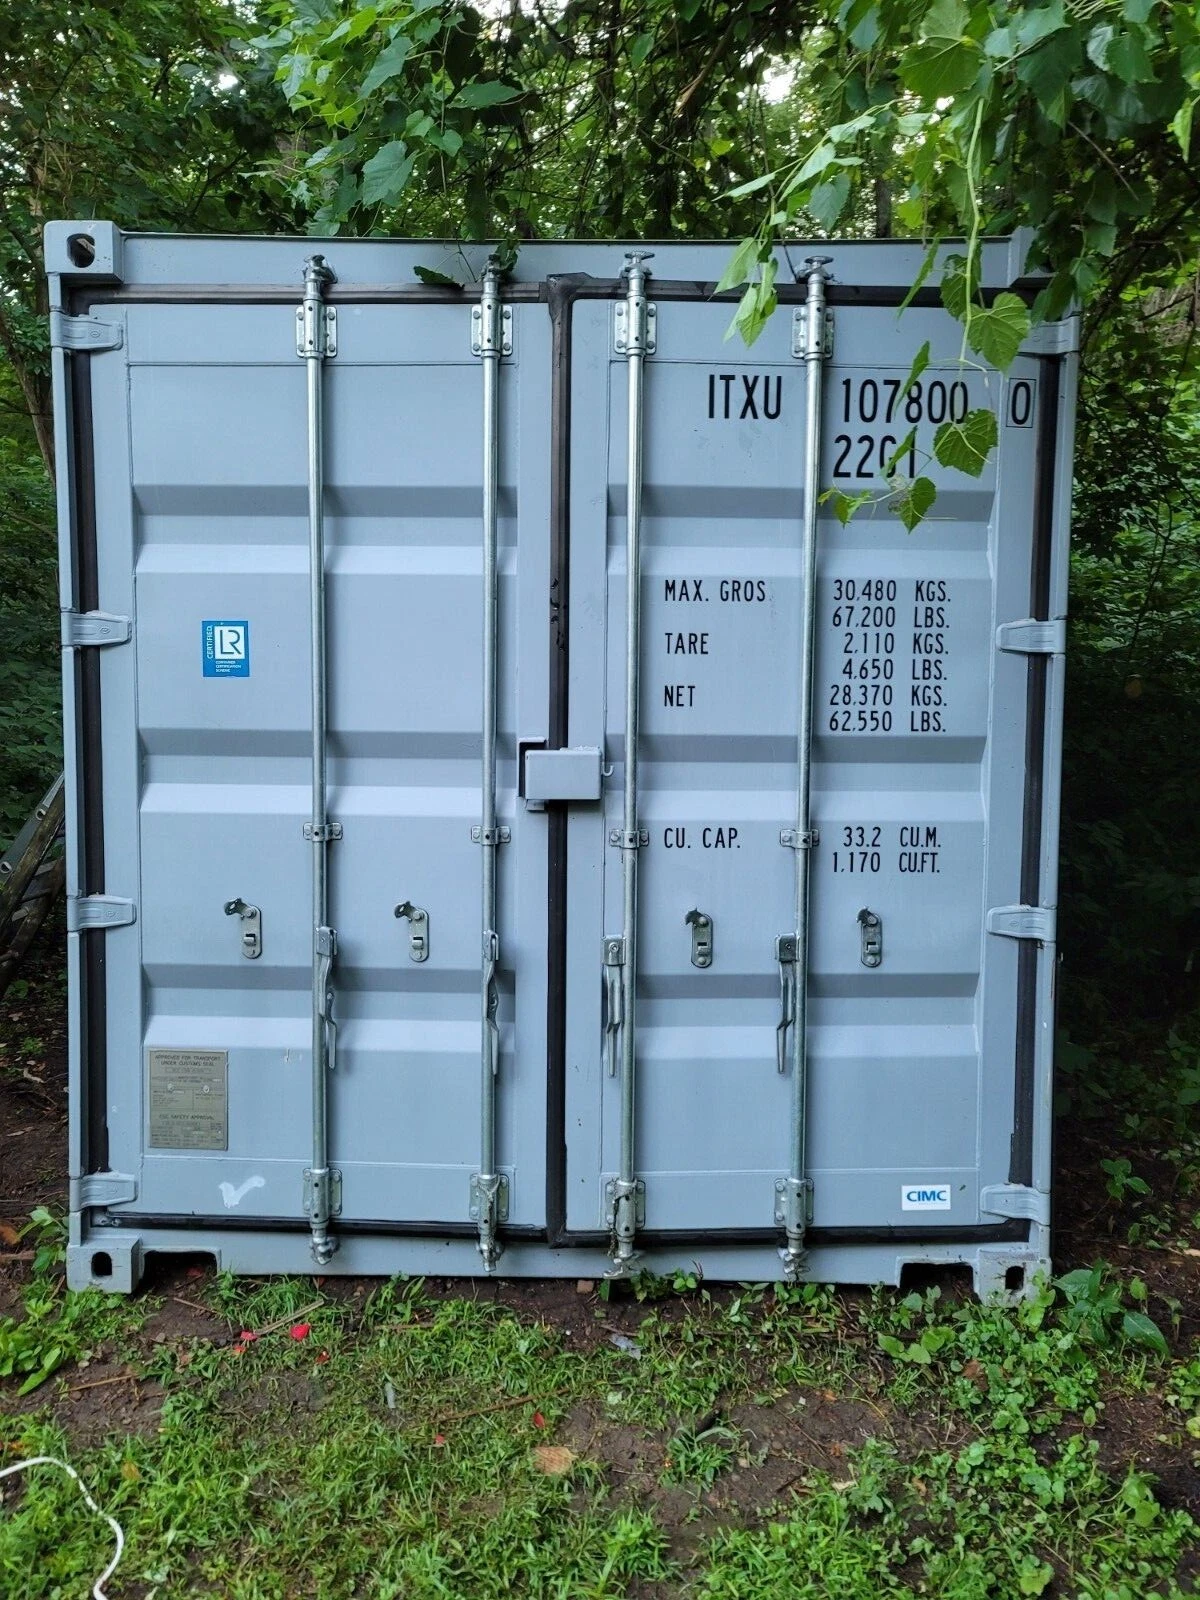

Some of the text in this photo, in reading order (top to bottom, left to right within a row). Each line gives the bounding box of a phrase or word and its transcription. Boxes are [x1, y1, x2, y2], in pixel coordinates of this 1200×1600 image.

[708, 374, 1032, 426] ITXU 107800 0
[664, 578, 952, 603] MAX. GROS 30,480 KGS.
[831, 605, 950, 629] 67,200 LBS.
[206, 624, 214, 660] CERTIFIED
[219, 629, 242, 655] LR
[664, 631, 949, 656] TARE 2,110 KGS.
[841, 657, 948, 681] 4,650 LBS.
[663, 683, 948, 708] NET 28,370 KGS.
[828, 709, 947, 733] 62,550 LBS.
[663, 825, 942, 849] CU. CAP. 33.2 CU.M.
[832, 851, 941, 874] 1,170 CU.FT.
[906, 1190, 947, 1202] CIMC
